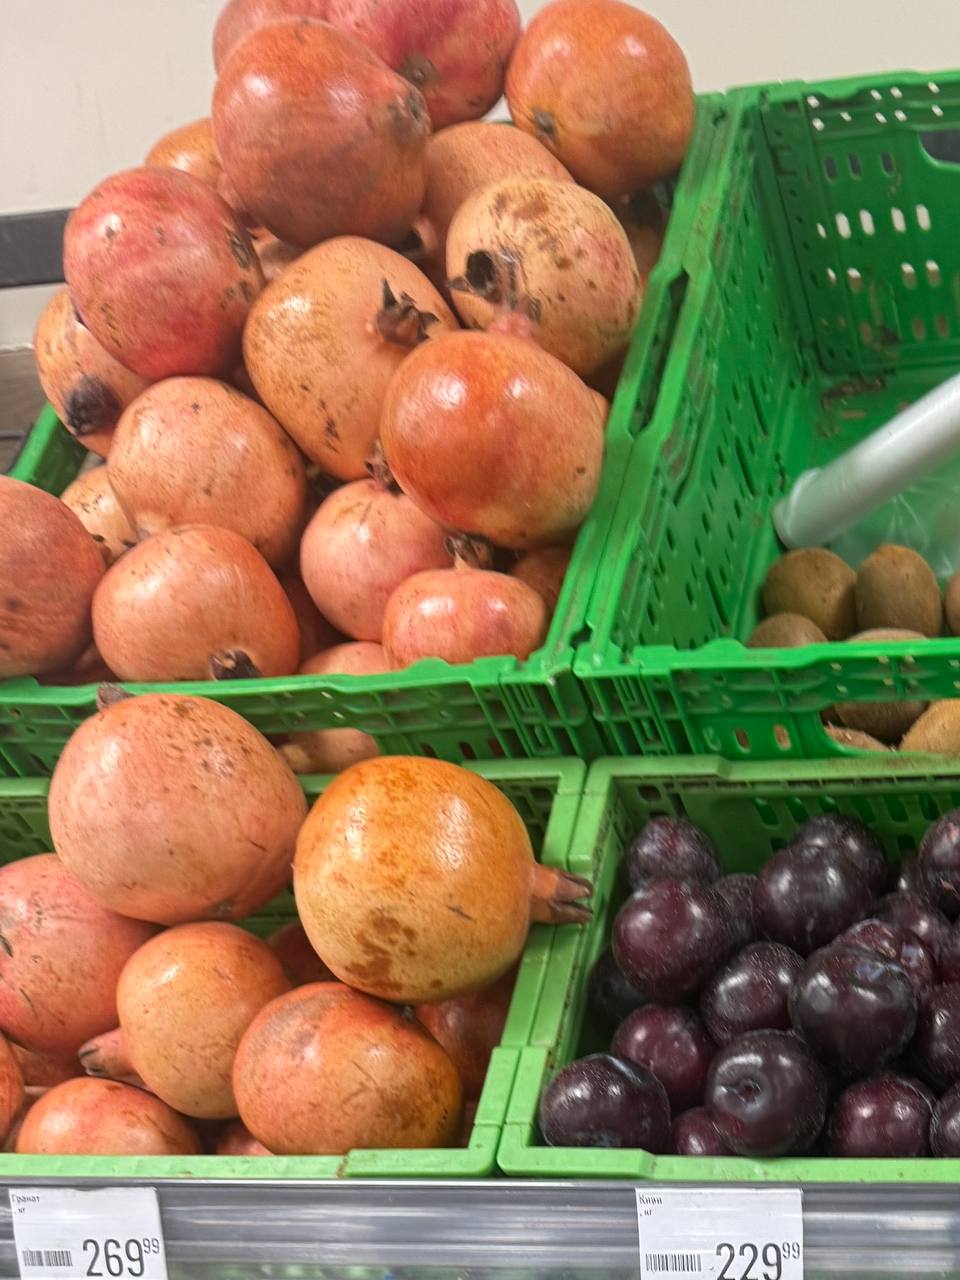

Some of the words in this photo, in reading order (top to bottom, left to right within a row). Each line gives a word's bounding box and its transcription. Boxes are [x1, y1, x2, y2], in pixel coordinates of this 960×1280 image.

[11, 1193, 40, 1203] Гранат
[639, 1194, 663, 1205] Киви
[82, 1238, 145, 1277] 269
